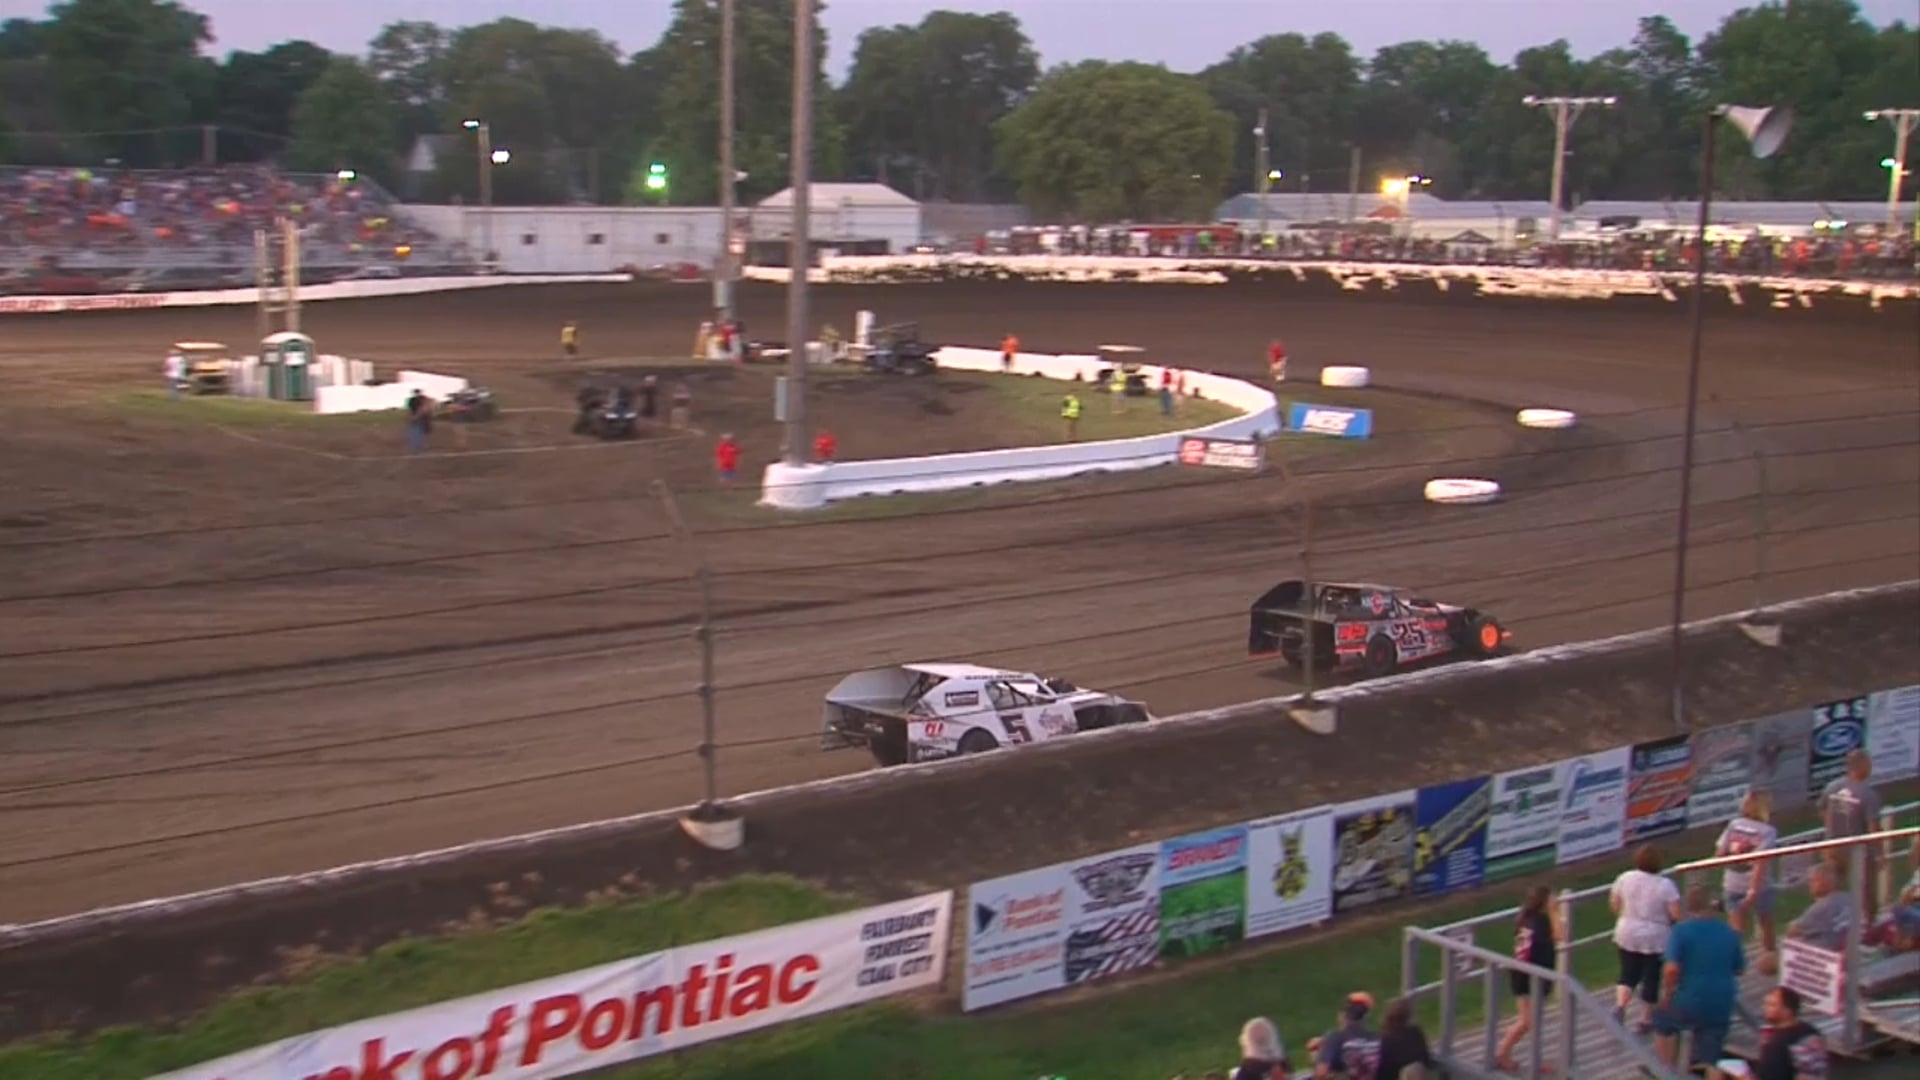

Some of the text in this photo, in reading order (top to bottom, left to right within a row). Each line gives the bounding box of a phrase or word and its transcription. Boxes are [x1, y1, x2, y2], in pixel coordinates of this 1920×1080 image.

[1001, 714, 1033, 744] 5
[421, 1005, 517, 1080] of
[519, 953, 820, 1067] Pontiac
